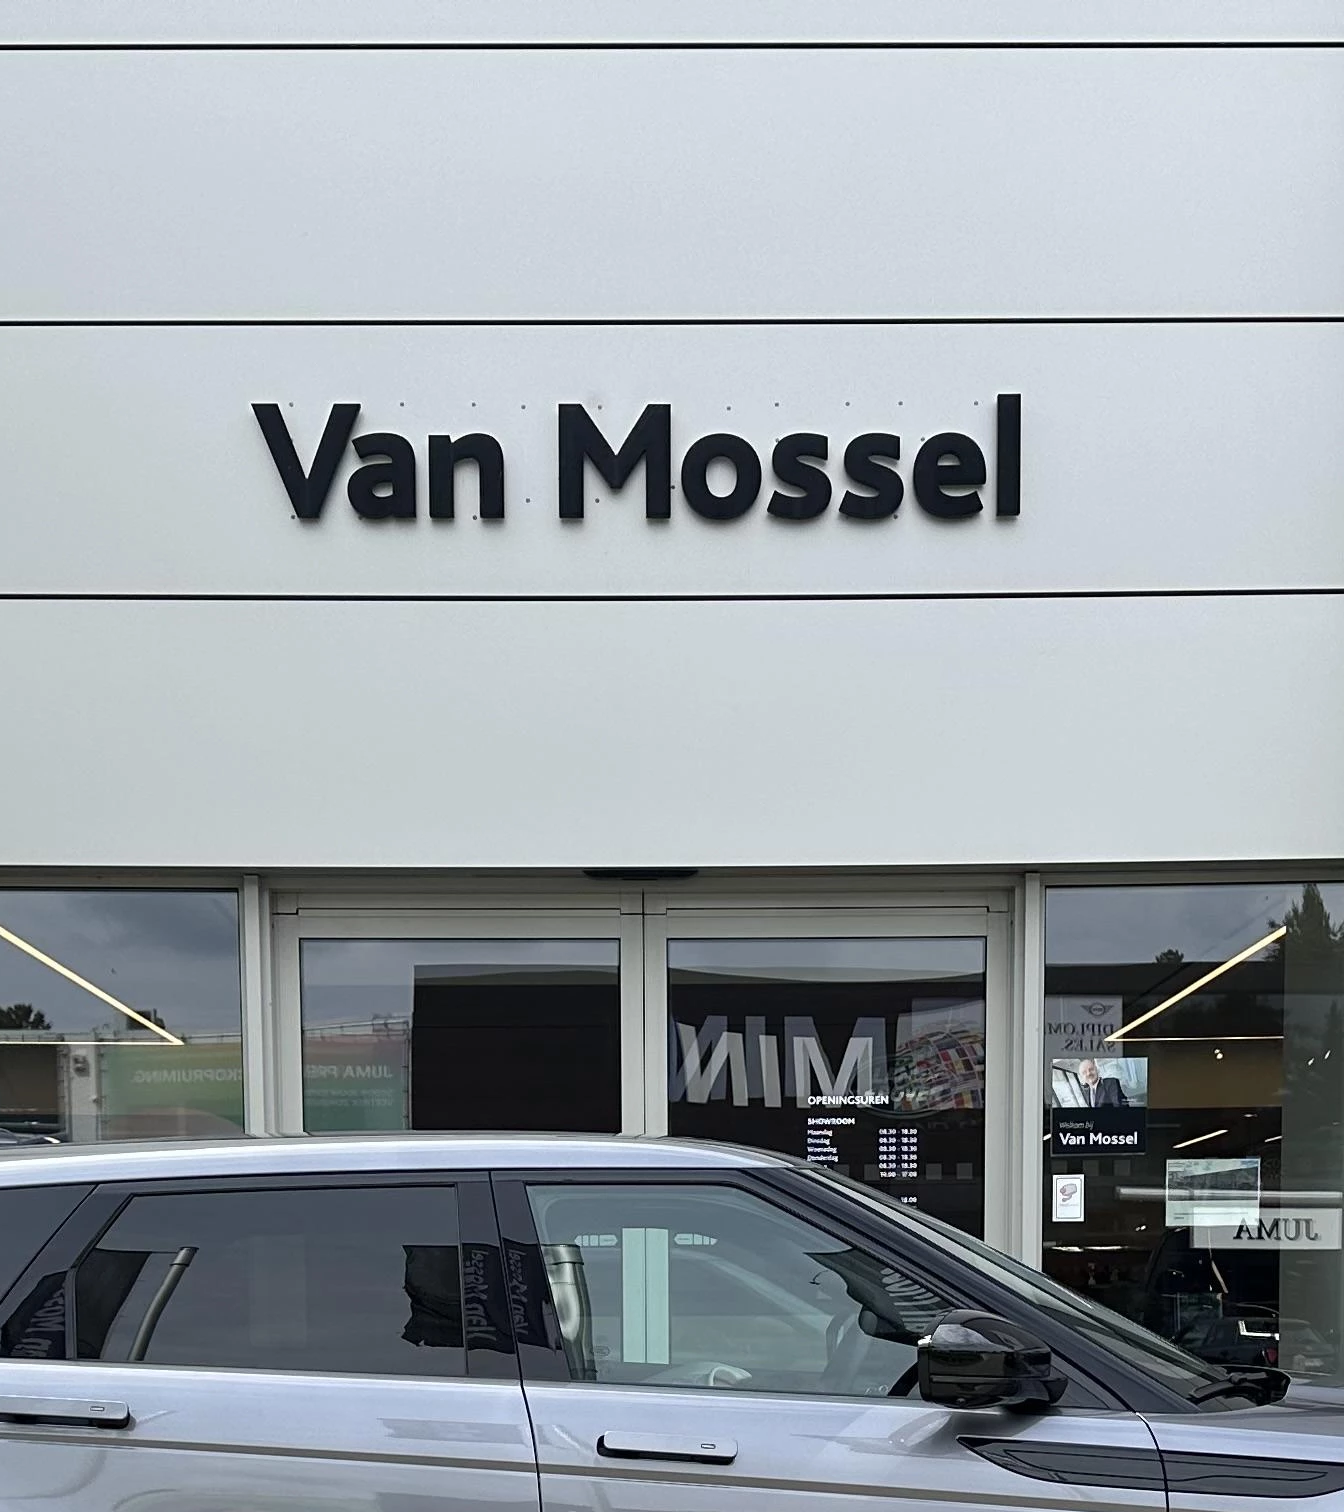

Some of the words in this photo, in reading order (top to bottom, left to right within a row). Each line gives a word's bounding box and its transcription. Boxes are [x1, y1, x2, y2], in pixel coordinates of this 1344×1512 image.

[250, 402, 506, 520] Van
[558, 393, 1022, 520] Mossel
[807, 1095, 890, 1105] OPENINGSUREN
[1058, 1132, 1086, 1146] Van
[1089, 1131, 1138, 1145] Mossel
